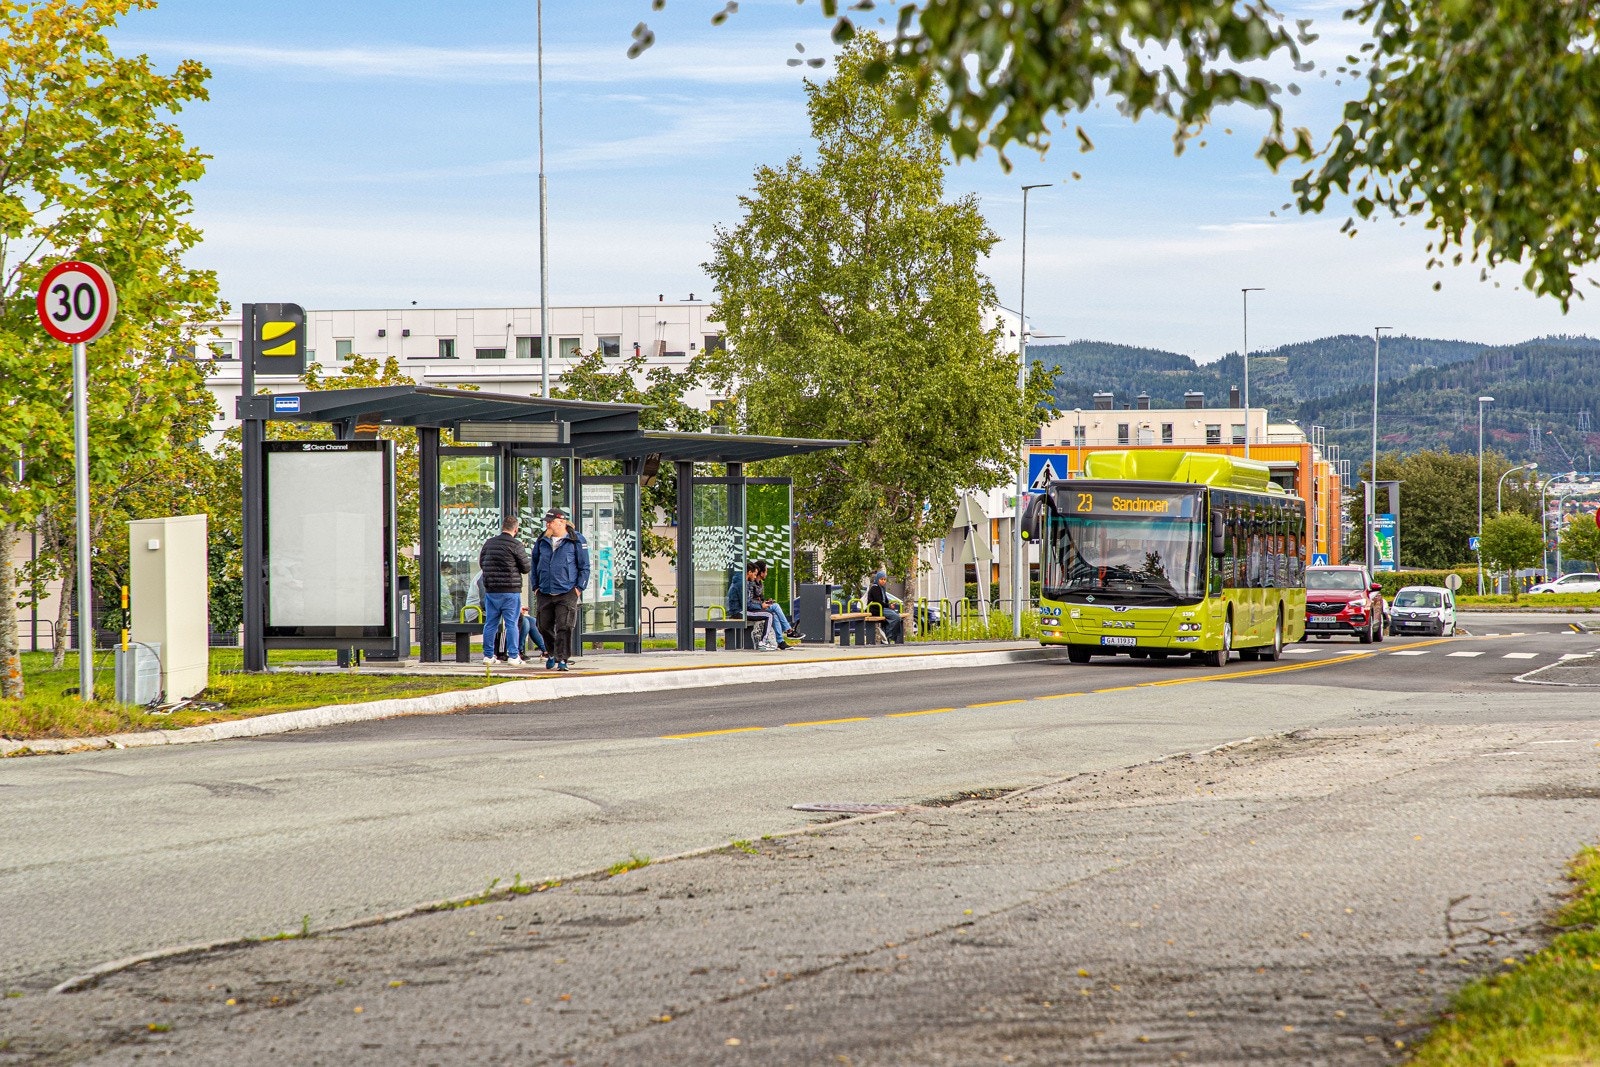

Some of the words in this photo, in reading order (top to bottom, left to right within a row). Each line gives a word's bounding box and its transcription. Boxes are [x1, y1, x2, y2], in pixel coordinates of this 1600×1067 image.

[51, 282, 96, 322] 30
[1077, 493, 1093, 512] 23
[1112, 496, 1169, 513] Sandmoen
[1102, 620, 1136, 628] MAN
[1117, 637, 1134, 645] 11932
